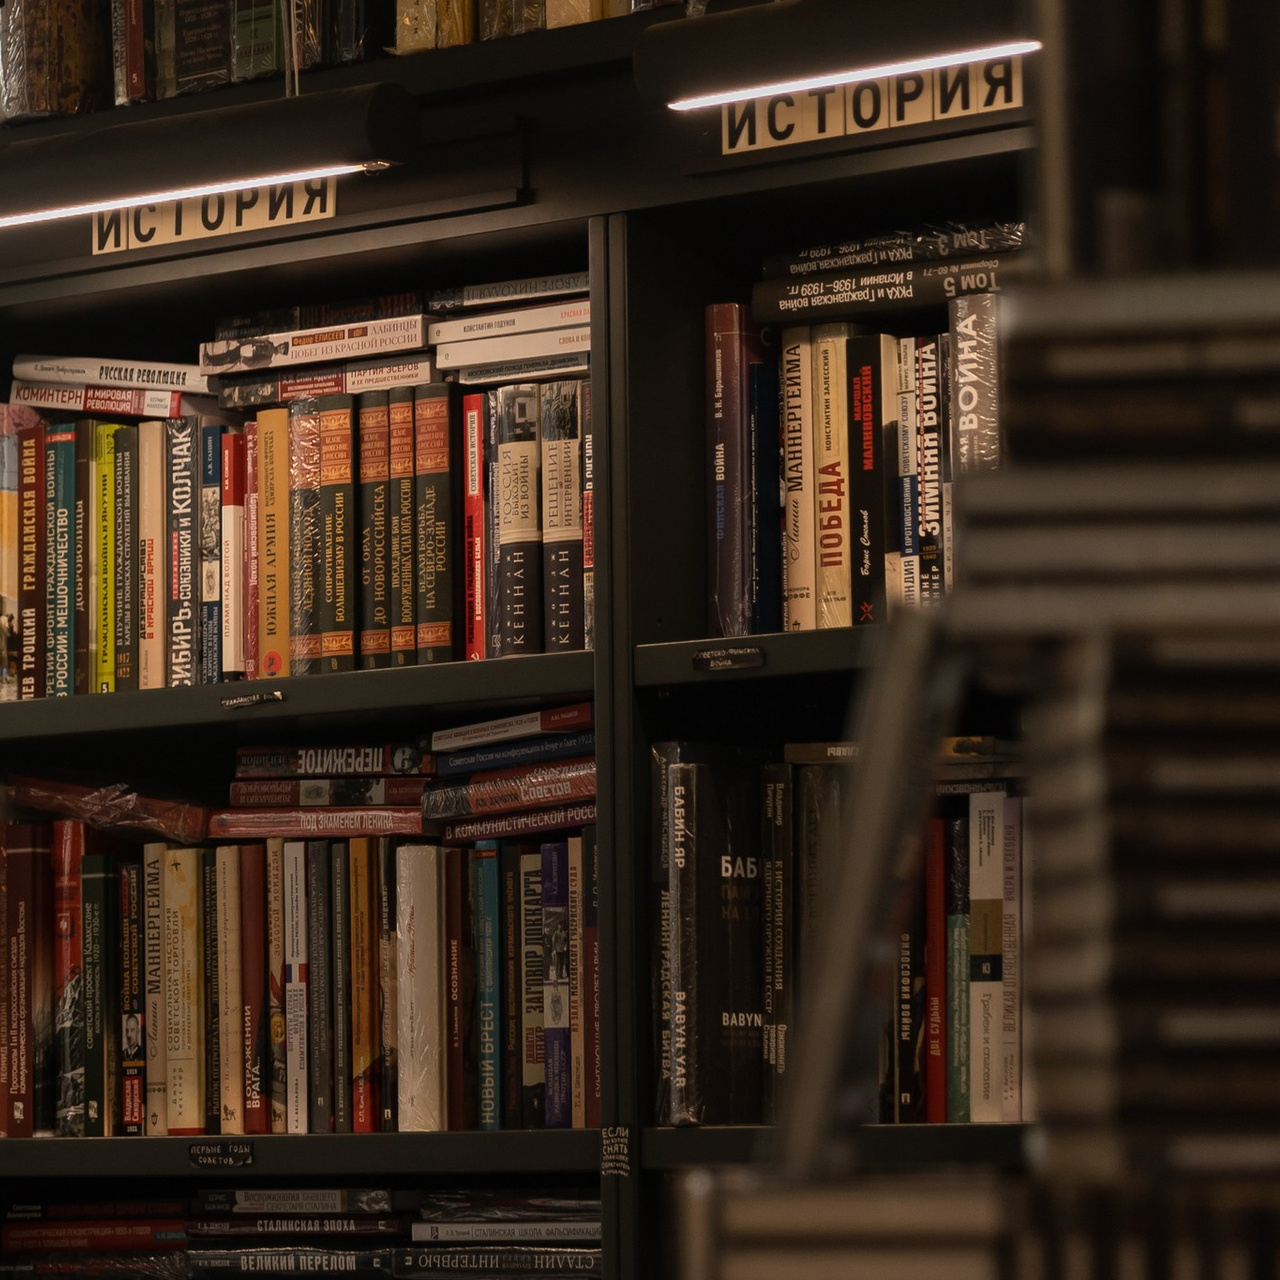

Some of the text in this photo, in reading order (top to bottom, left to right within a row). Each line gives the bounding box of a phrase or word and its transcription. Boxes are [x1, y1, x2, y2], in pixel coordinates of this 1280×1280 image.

[727, 60, 1013, 148] ИСТОРИЯ
[97, 177, 327, 250] ИСТОРИЯ
[888, 247, 912, 261] РККА
[779, 285, 913, 311] РККА Гражданская война
[861, 273, 904, 286] Испании
[943, 272, 999, 297] Том 5
[291, 333, 417, 359] ПОБЕГ ИЗ КРАСНОЙ РОССИИ
[100, 365, 133, 382] РУССКАЯ
[137, 368, 187, 385] РЕВОЛЮЦИЯ
[350, 362, 419, 378] ПАРТИЯ ЭСЕРОВ
[955, 314, 980, 431] ВОЙНА
[15, 386, 83, 404] КОМИНТЕРН
[87, 400, 131, 411] РЕВОЛЮЦИЯ
[94, 389, 132, 400] МИРОВАЯ
[853, 377, 862, 420] МАРШАЛ
[785, 344, 803, 492] МАННЕРГЕЙМА
[860, 365, 873, 470] МАЛИНОВСКИЙ
[714, 443, 725, 480] ВОЙНА
[818, 349, 845, 567] ПОБЕДА КОНСТАНТИН ЗАЛЕССКИЙ
[502, 449, 512, 524] РОССИЯ
[172, 428, 192, 600] СОЮЗНИКИ КОЛЧАК
[335, 492, 344, 534] РОССИИ
[22, 438, 36, 670] ТРОЦКИЙ ГРАЖДАНСКАЯ ВОЙНА
[46, 450, 56, 647] ФРОНТ ГРАЖДАНСКОЙ ВОЙНЫ
[436, 521, 446, 572] РОССИИ
[56, 508, 68, 628] МЕШОЧНИЧЕСТВО
[265, 513, 277, 636] ЮЖНАЯ АРМИЯ
[513, 551, 525, 645] КЕННАН
[559, 549, 570, 645] КЕННАН
[297, 746, 383, 775] ПЕРЕЖИТОЕ
[300, 814, 393, 830] ПОД ЗНАМЕНЕМ ЛЕНИНА
[454, 812, 565, 838] КОММУНИСТИЧЕСКОЙ
[674, 786, 686, 868] БАБИН ЯР
[147, 859, 161, 994] МАННЕРГЕЙМА
[523, 869, 544, 1014] ЗАГОВОР ЛОККАРТА
[675, 991, 686, 1087] BABYN YAR
[901, 1004, 913, 1040] ВОЙНЫ
[480, 1000, 495, 1124] НОВЫЙ БРЕСТ
[662, 1029, 671, 1080] БИТВА
[602, 1127, 629, 1138] ЕСЛИ
[603, 1144, 628, 1154] СНЯТЬ
[198, 1156, 234, 1165] СОВЕТОВ
[257, 1219, 355, 1231] СТАЛИНСКАЯ ЭПОХА
[241, 1255, 356, 1271] ВЕЛИКИЙ ПЕРЕЛОМ
[533, 1255, 594, 1269] СТАЛИН
